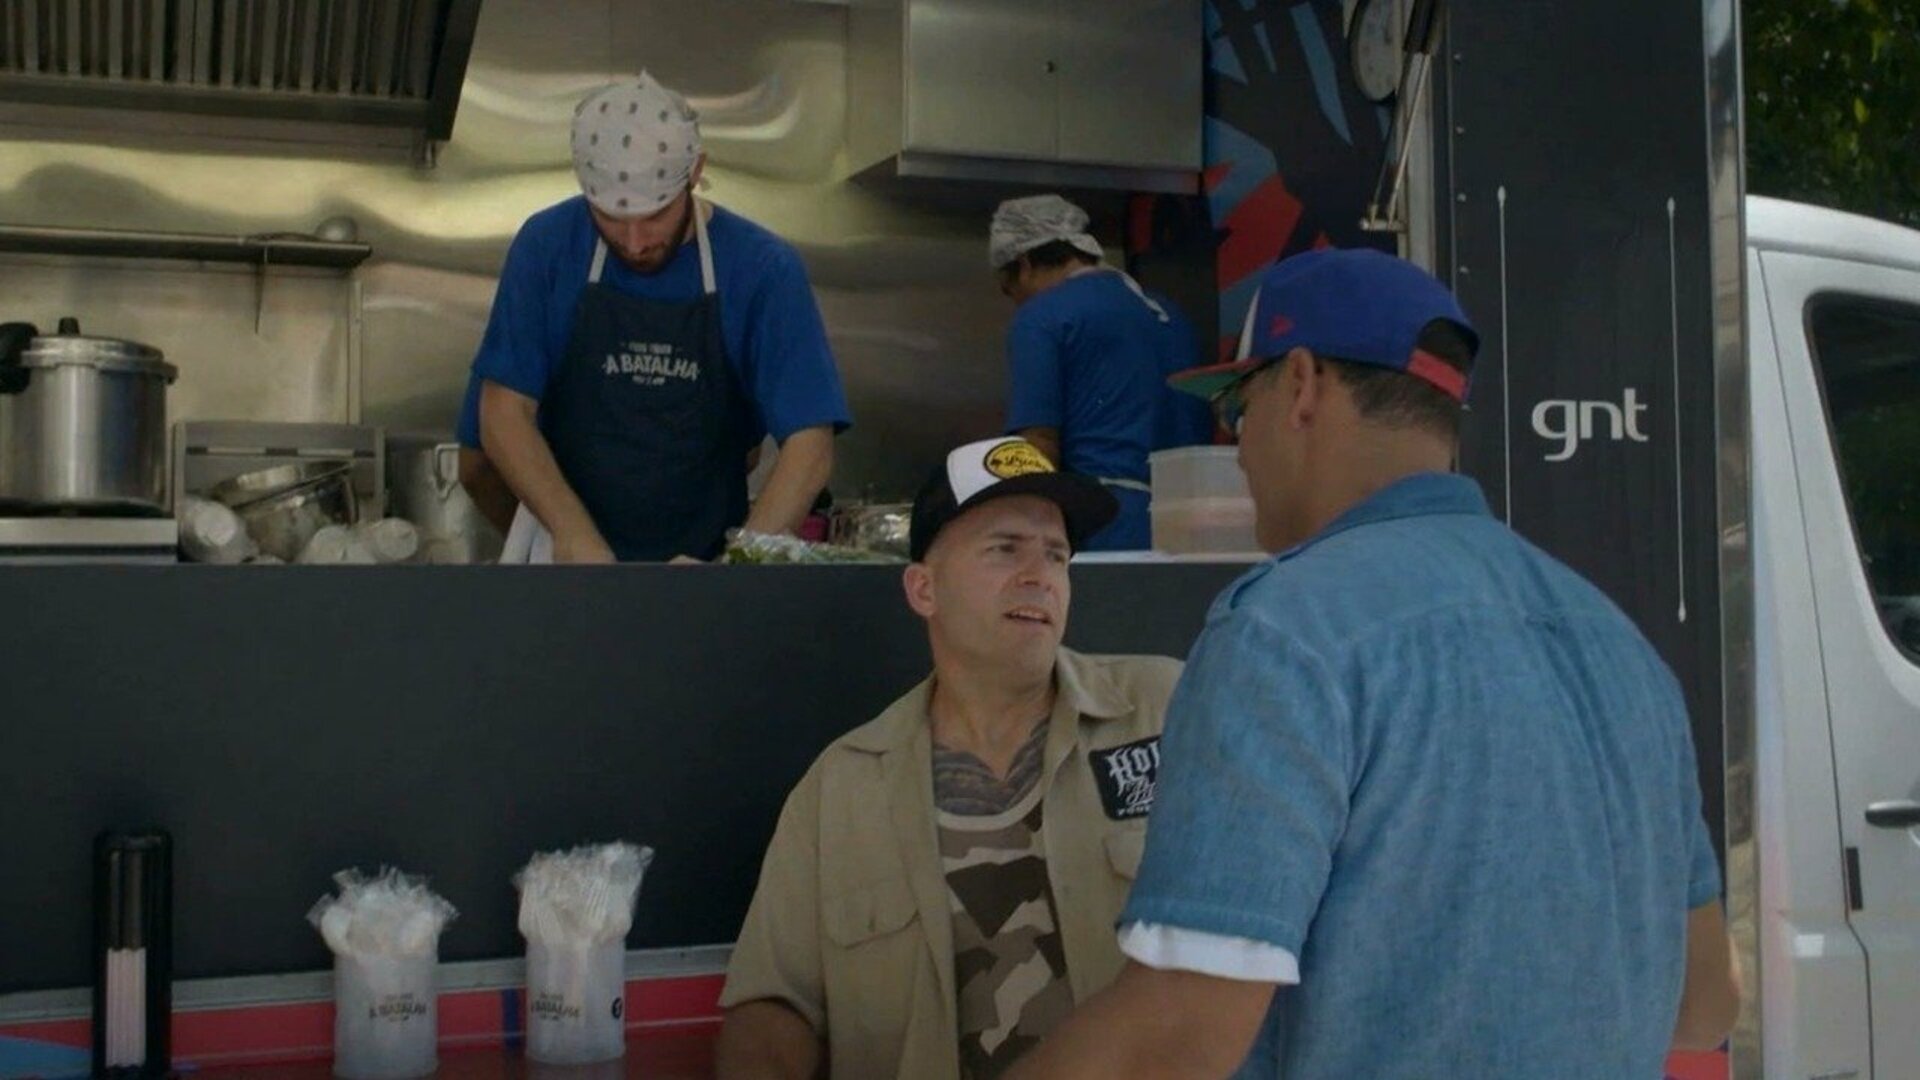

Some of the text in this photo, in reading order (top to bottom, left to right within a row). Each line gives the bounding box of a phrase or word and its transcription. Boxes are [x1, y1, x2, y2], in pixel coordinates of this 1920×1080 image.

[605, 353, 619, 375] A
[620, 353, 699, 382] BATALHA
[1531, 387, 1649, 462] gnt
